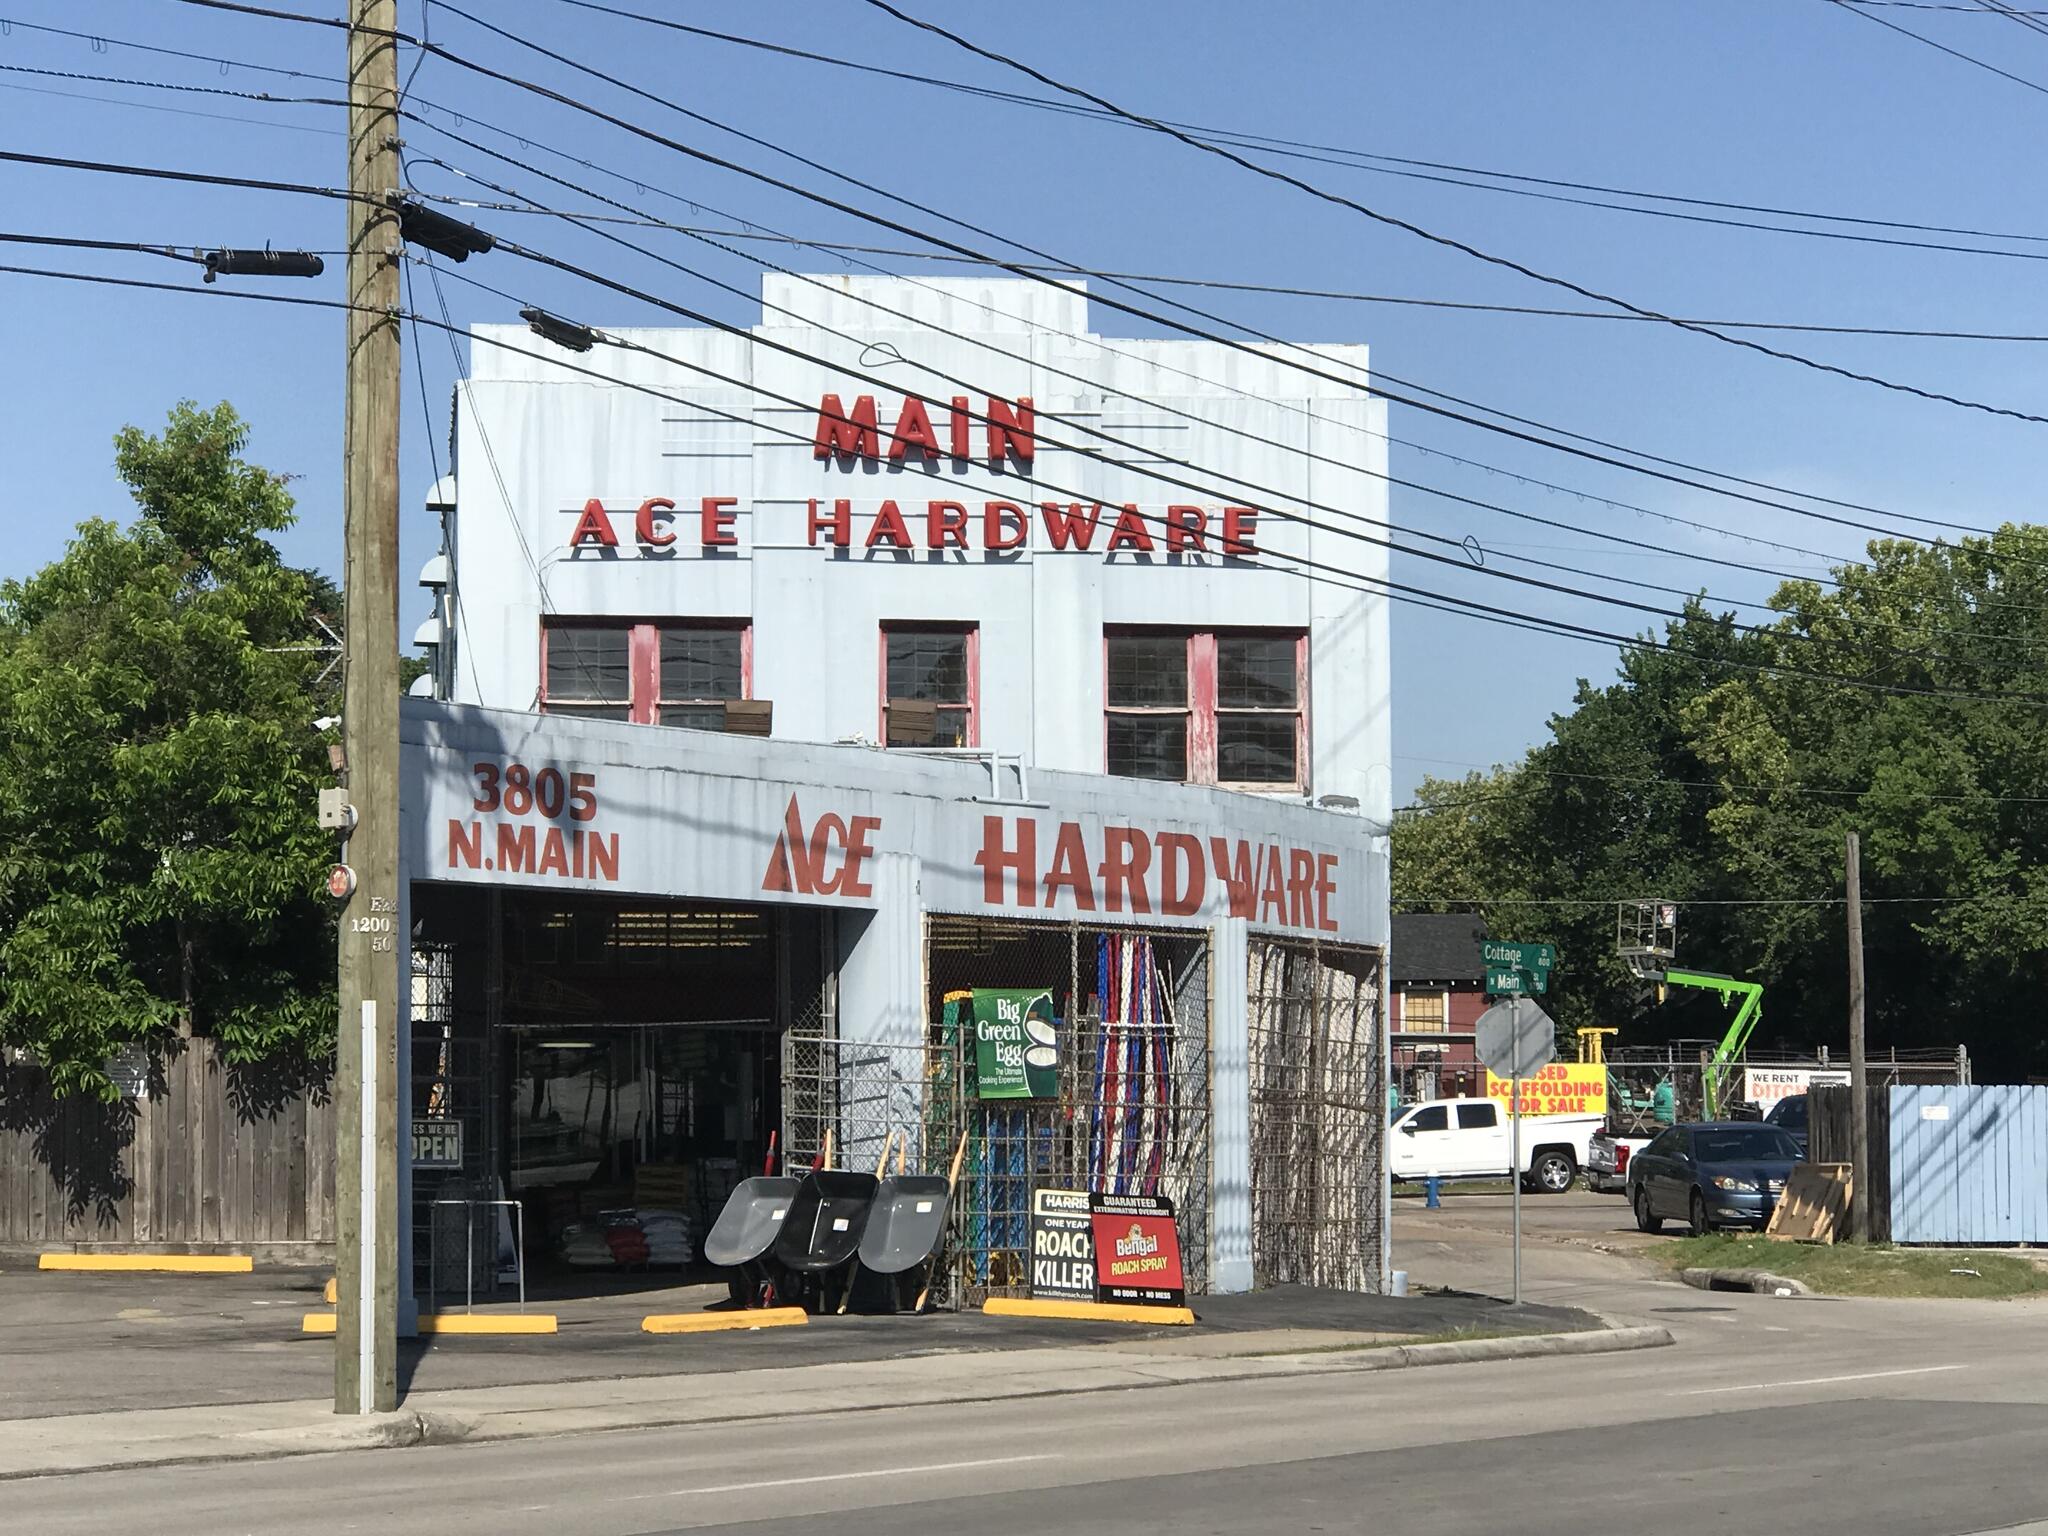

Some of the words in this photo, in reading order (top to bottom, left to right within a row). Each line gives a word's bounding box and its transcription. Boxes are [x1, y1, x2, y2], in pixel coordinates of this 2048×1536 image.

[814, 394, 1034, 462] MAIN
[570, 497, 738, 547] ACE
[808, 500, 1259, 554] HARDWARE
[473, 763, 597, 822] 3805
[448, 818, 620, 881] N.MAIN
[761, 791, 882, 897] ACE
[974, 815, 1339, 932] HARDWARE
[352, 917, 390, 932] 1200
[1485, 945, 1522, 965] Cottage
[1497, 974, 1520, 989] Main
[997, 998, 1021, 1024] Big
[978, 1020, 1021, 1041] Green
[995, 1041, 1021, 1066] Egg
[1753, 1074, 1769, 1082] WE
[1772, 1074, 1799, 1083] RENT
[1547, 1098, 1586, 1113] SALE
[413, 1124, 425, 1134] ES
[428, 1124, 457, 1134] WE'RE
[1046, 1194, 1090, 1209] HARRIS
[1103, 1196, 1157, 1208] GUARANTEED
[1045, 1218, 1065, 1228] ONE
[1116, 1234, 1158, 1257] Bengal
[1034, 1260, 1094, 1290] KILLER
[1111, 1259, 1140, 1276] ROACH
[1140, 1256, 1168, 1272] SPRAY
[1112, 1289, 1121, 1297] NO
[1145, 1290, 1154, 1298] NO
